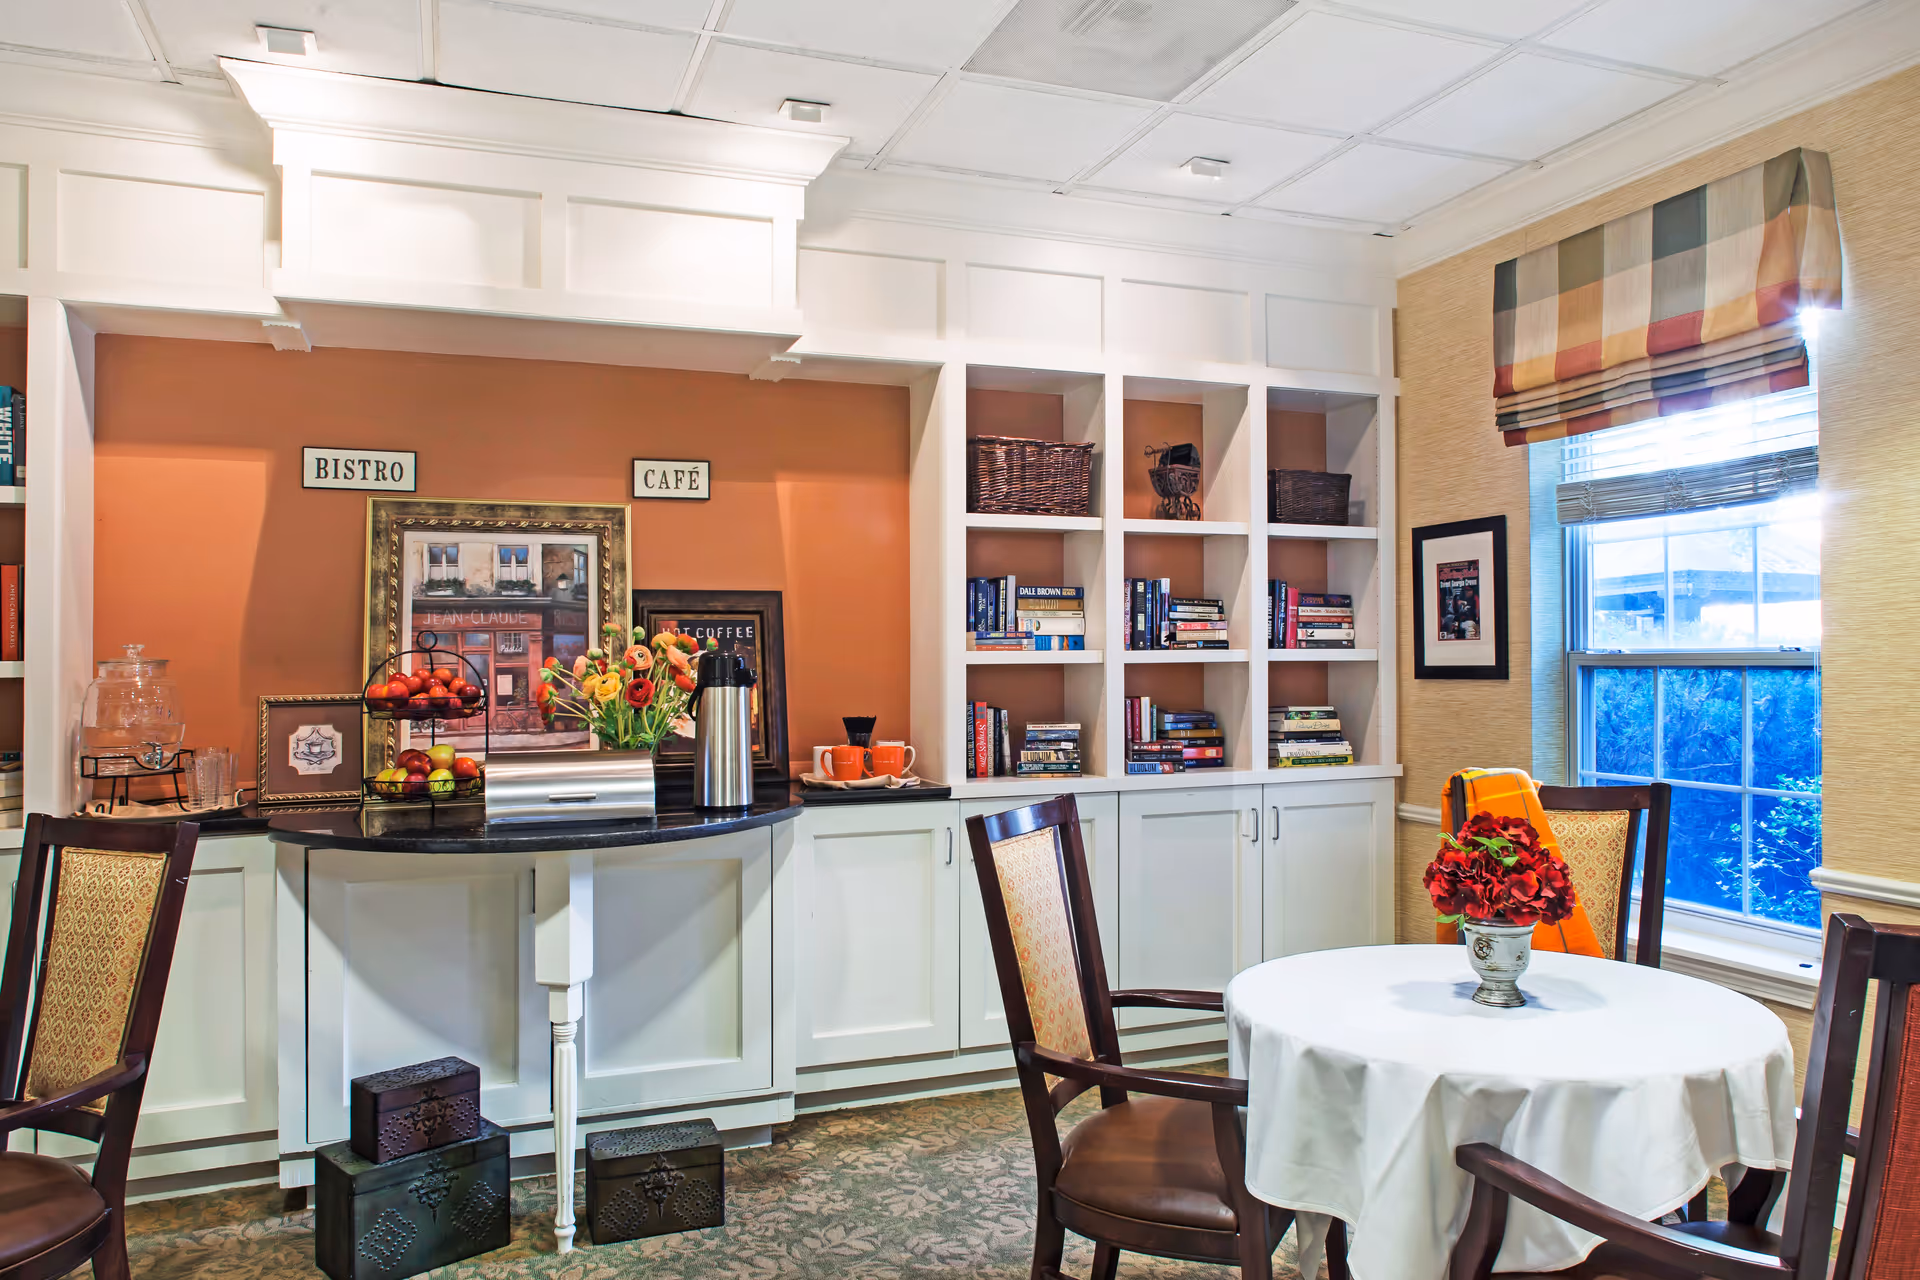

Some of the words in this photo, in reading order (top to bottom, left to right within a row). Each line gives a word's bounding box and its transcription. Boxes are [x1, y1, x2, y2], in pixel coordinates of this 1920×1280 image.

[0, 407, 12, 464] WHITE
[315, 457, 403, 482] BISTRO
[644, 466, 699, 490] CAFÉ
[1020, 587, 1036, 595] DALE
[423, 609, 528, 625] JEAN-CLAUDE
[9, 621, 15, 629] IN
[696, 626, 753, 638] COFFEE
[1134, 763, 1156, 772] LUDLUM
